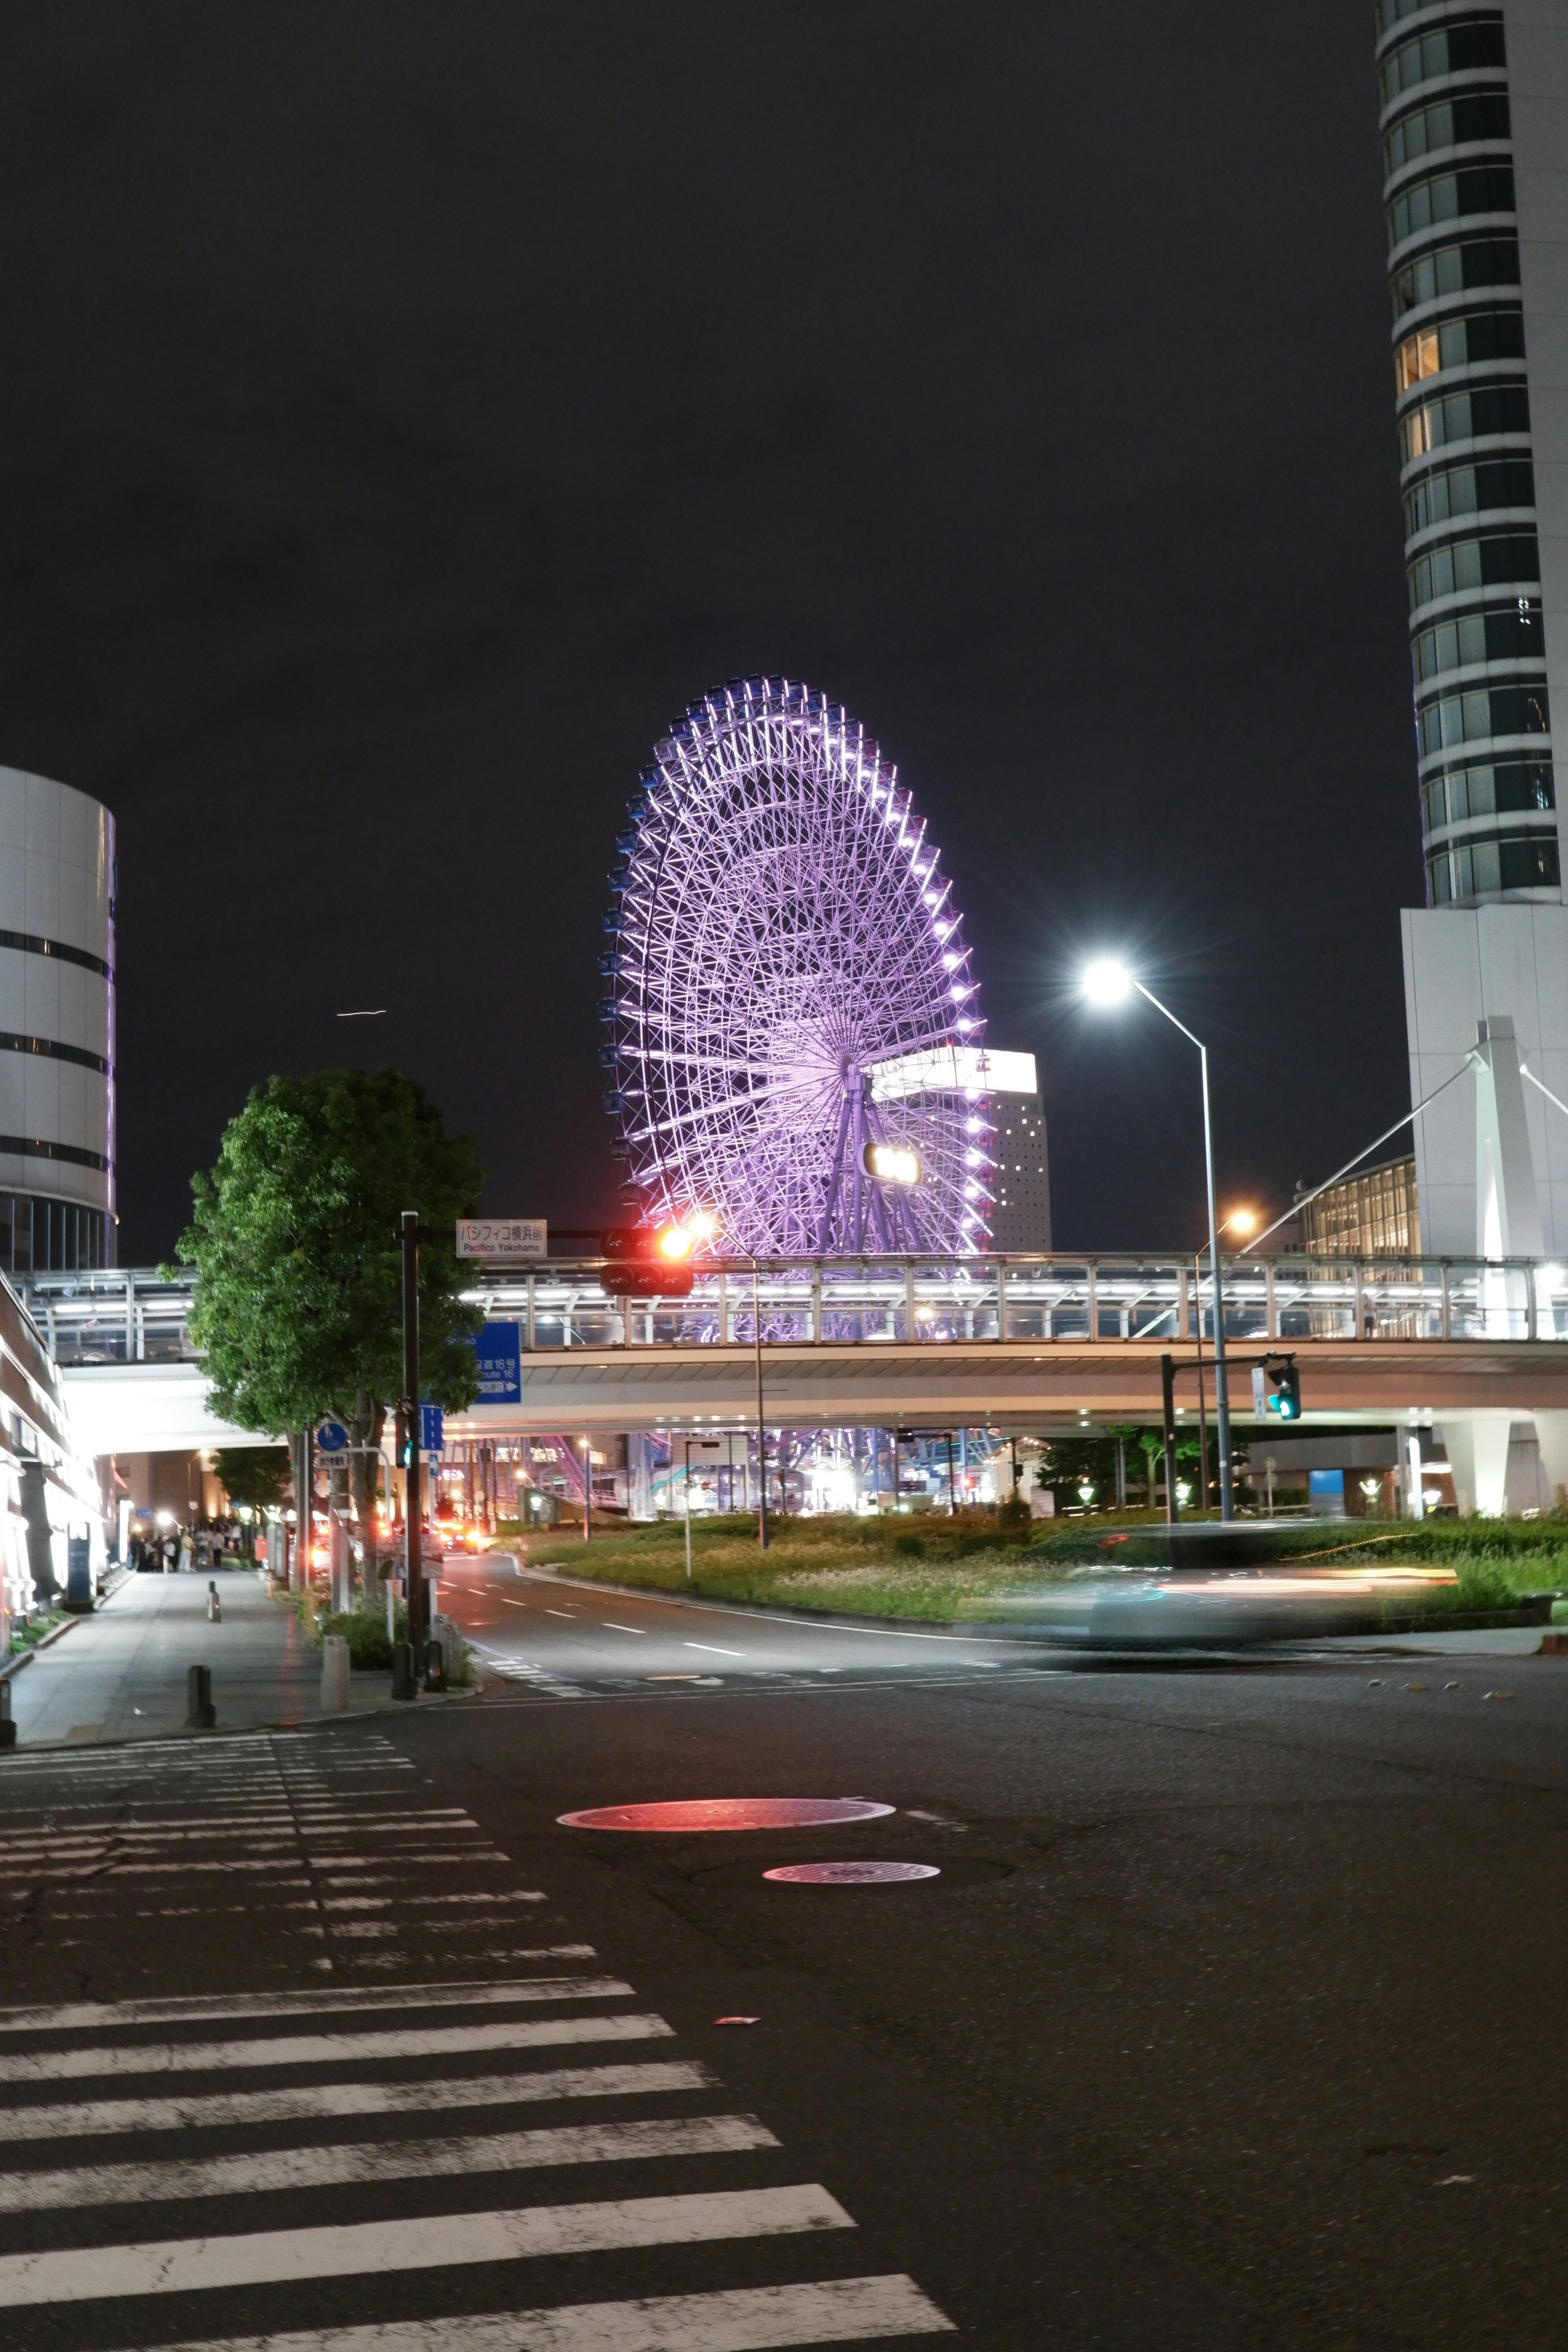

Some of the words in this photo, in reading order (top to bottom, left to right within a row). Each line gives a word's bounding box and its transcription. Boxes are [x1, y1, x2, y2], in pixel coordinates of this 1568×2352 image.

[461, 1225, 543, 1241] パシフィコ横浜前
[463, 1243, 495, 1252] Pacifico
[498, 1243, 540, 1252] Yokohama
[504, 1369, 514, 1378] 16
